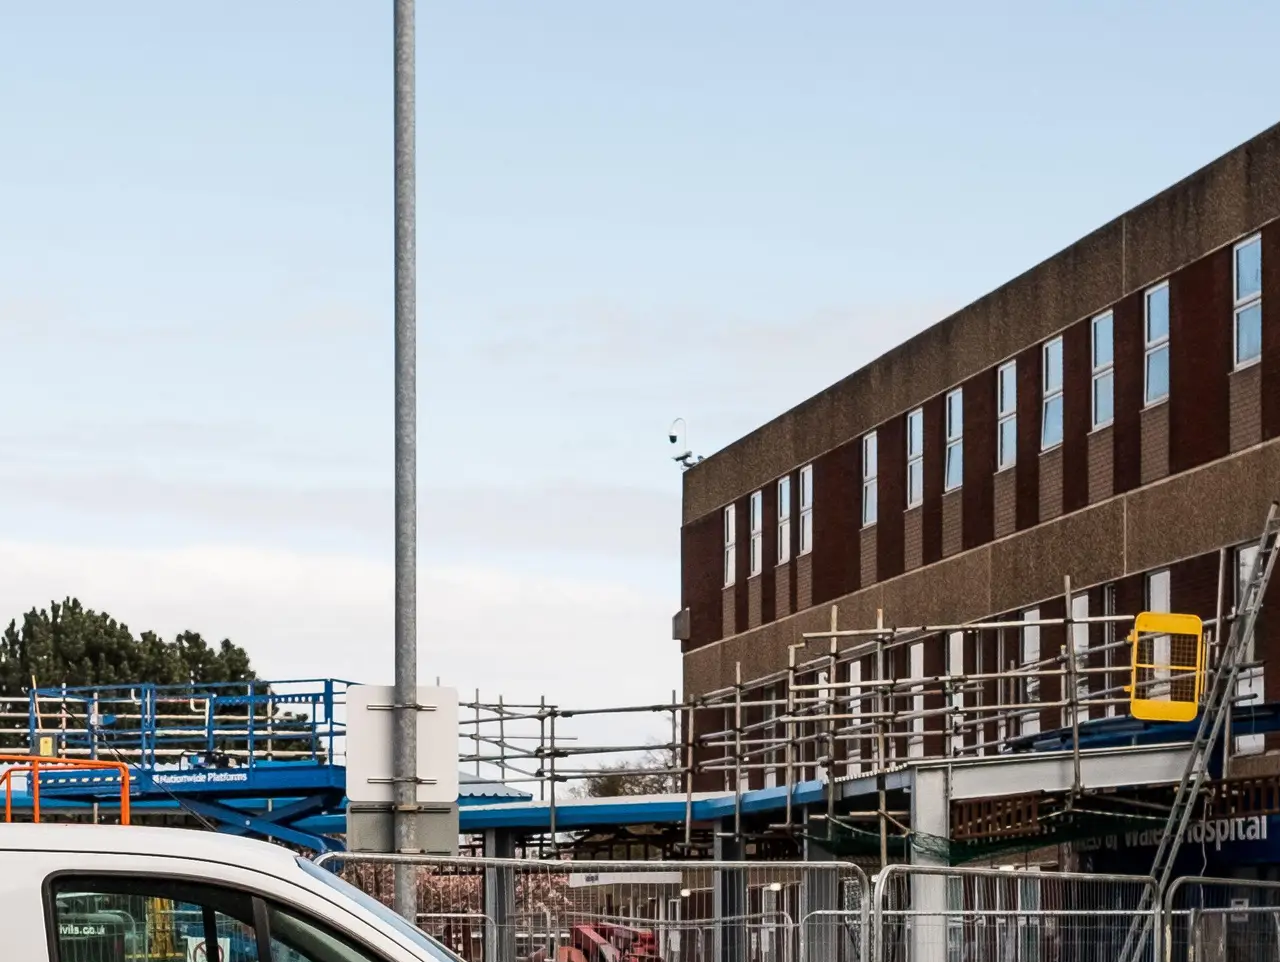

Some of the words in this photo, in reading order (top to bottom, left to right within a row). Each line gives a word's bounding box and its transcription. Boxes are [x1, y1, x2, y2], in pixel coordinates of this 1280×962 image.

[160, 772, 207, 783] Nationwide
[208, 771, 248, 782] Platforms
[60, 923, 106, 935] ivils.co.uk
